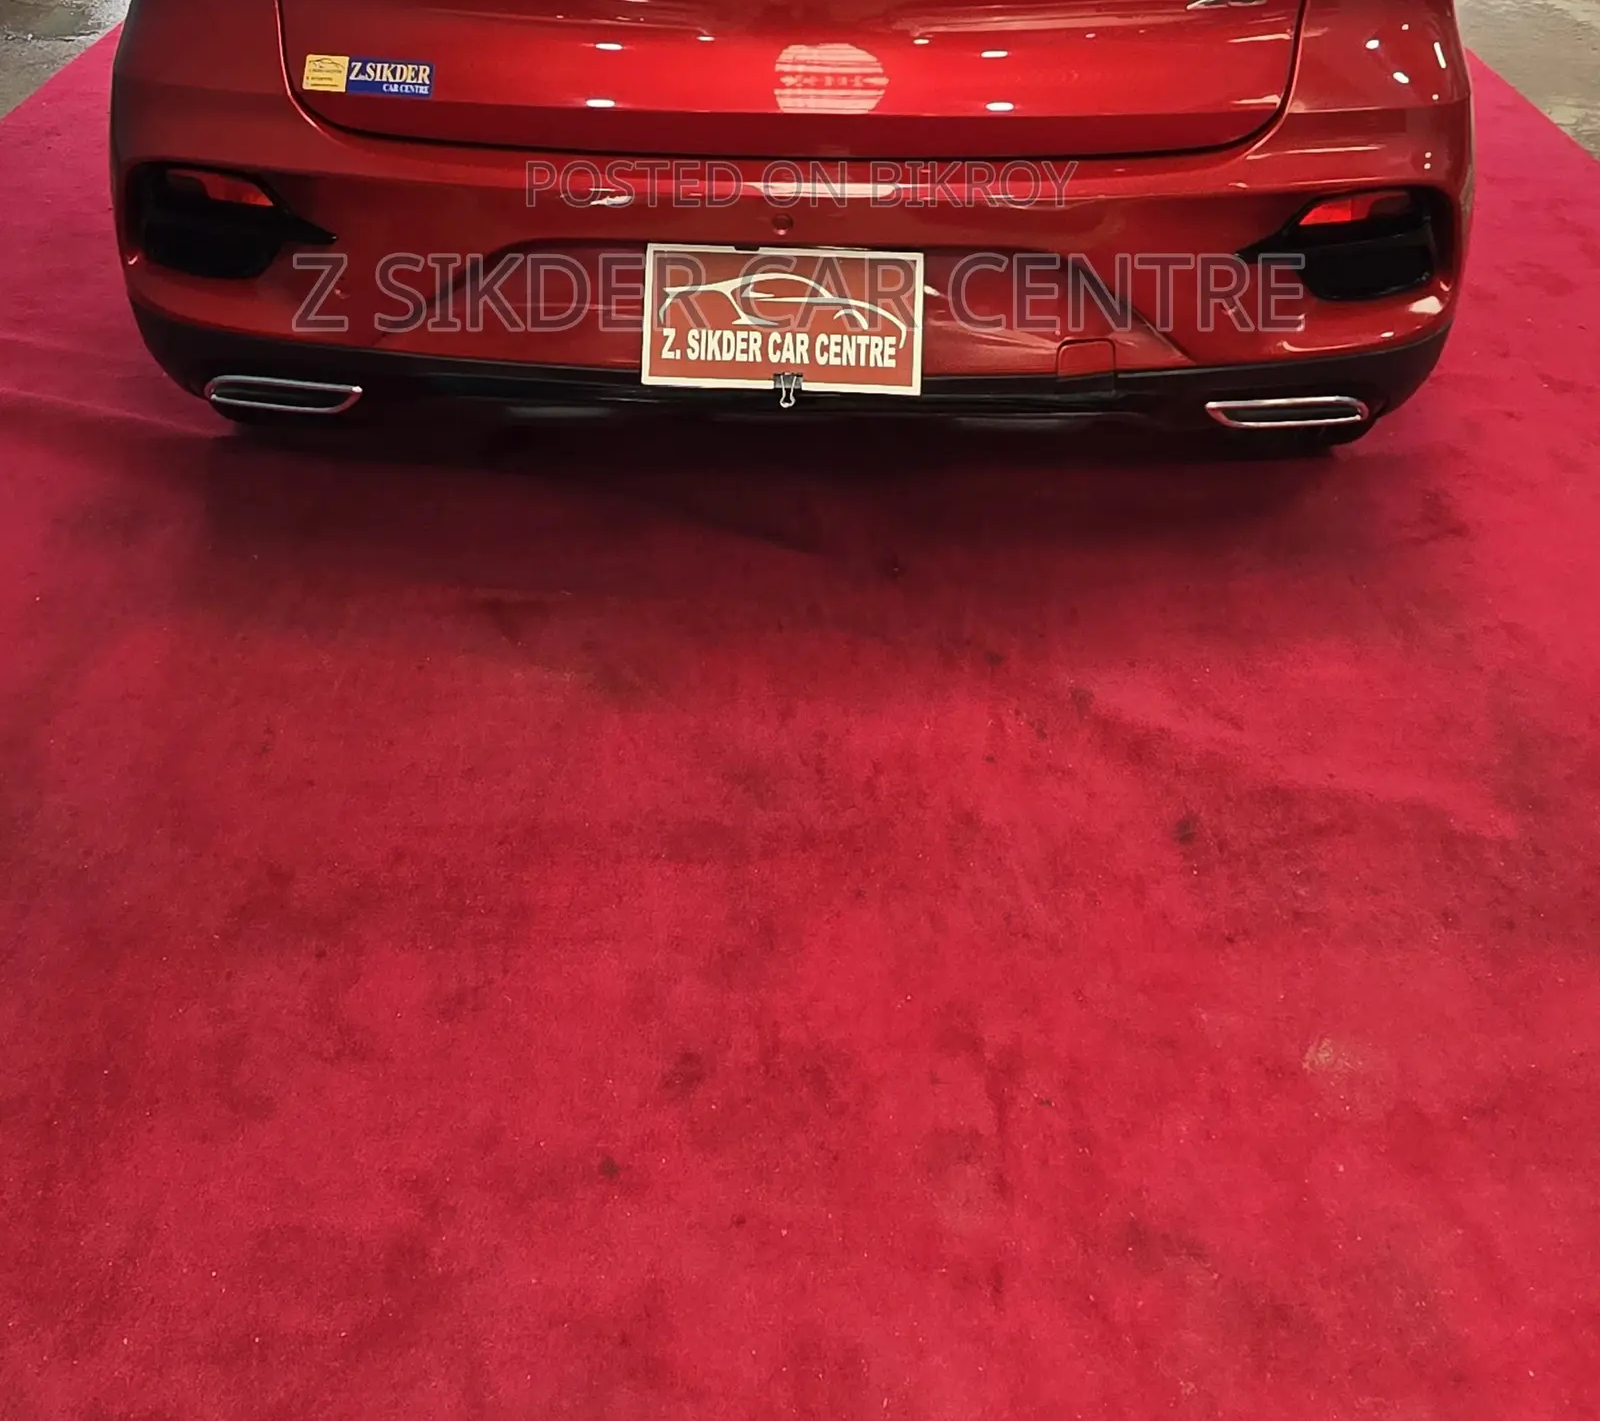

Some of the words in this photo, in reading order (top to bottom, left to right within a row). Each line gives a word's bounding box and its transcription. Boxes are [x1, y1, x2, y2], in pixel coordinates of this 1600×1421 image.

[382, 83, 398, 93] CAR
[399, 83, 430, 95] CENTRE
[660, 328, 681, 360] Z.
[686, 329, 762, 363] SIKDER
[767, 331, 810, 365] CAR
[815, 333, 897, 368] CENTRE
